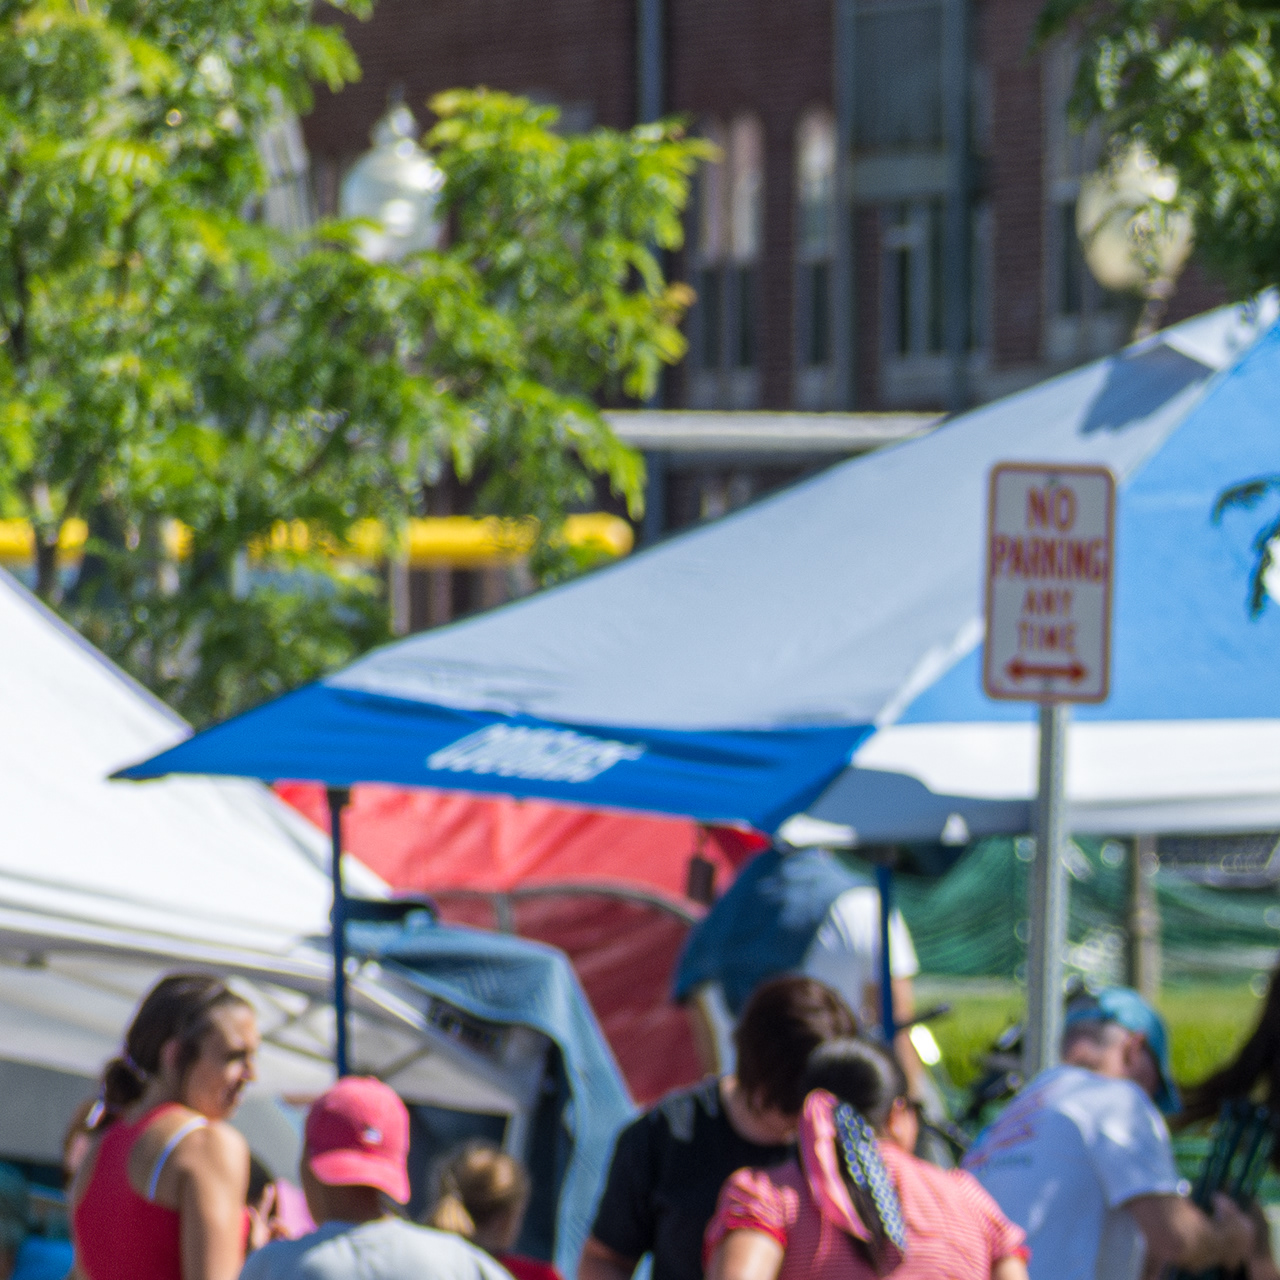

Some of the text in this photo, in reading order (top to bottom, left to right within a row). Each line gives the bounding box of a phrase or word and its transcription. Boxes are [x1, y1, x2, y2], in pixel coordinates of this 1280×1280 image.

[1027, 486, 1076, 532] NO
[993, 534, 1108, 583] PARKING
[1024, 587, 1073, 617] ANY
[1018, 620, 1077, 655] TIME
